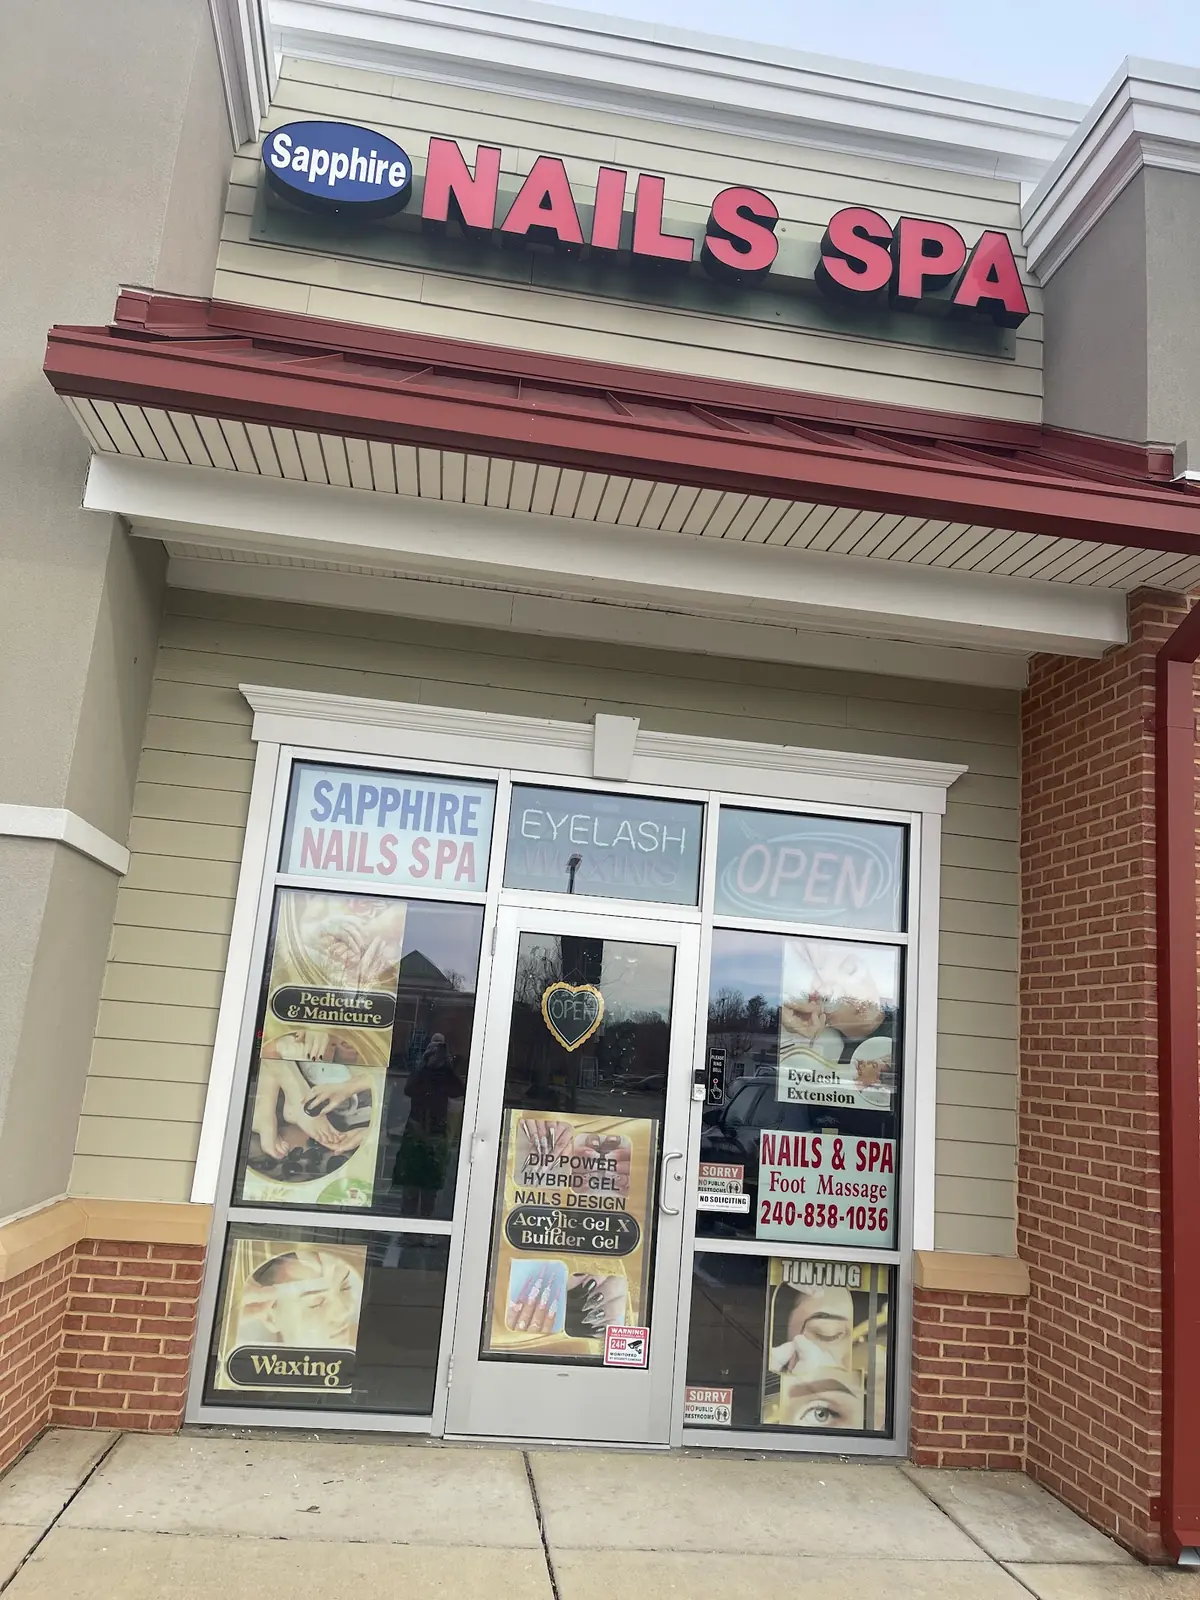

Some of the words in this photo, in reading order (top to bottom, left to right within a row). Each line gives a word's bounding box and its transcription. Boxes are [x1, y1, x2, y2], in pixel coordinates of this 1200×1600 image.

[270, 133, 408, 188] Sapphire
[422, 136, 780, 272] NAILS
[821, 206, 1031, 315] SPA
[310, 779, 482, 837] SAPPHIRE
[521, 808, 686, 855] EYELASH
[300, 827, 399, 877] NAILS
[408, 836, 477, 884] SPA
[736, 844, 875, 909] OPEN
[299, 991, 374, 1010] Pedicure
[551, 999, 596, 1021] OPEN
[287, 1004, 300, 1018] &
[303, 1006, 382, 1025] Manicure
[787, 1069, 841, 1086] Eyelash
[787, 1086, 856, 1105] Extension
[528, 1153, 555, 1167] DIP
[560, 1155, 618, 1172] POWER
[761, 1133, 823, 1170] NAILS
[831, 1137, 846, 1171] &
[855, 1140, 894, 1174] SPA
[523, 1172, 584, 1188] HYBRID
[588, 1176, 620, 1192] GEL
[702, 1166, 739, 1178] SORRY
[769, 1171, 806, 1194] Foot
[816, 1174, 888, 1204] Massage
[514, 1191, 562, 1207] NAILS
[566, 1194, 627, 1211] DESIGN
[710, 1196, 747, 1205] SOLICITING
[616, 1218, 631, 1233] X
[760, 1200, 889, 1232] 240-838-1036
[521, 1227, 586, 1248] Builder
[591, 1234, 620, 1250] Gel
[781, 1259, 862, 1288] TINTING
[611, 1327, 645, 1336] WARNING
[612, 1339, 626, 1349] 24H
[250, 1354, 342, 1387] Waxing
[689, 1390, 728, 1402] SORRY
